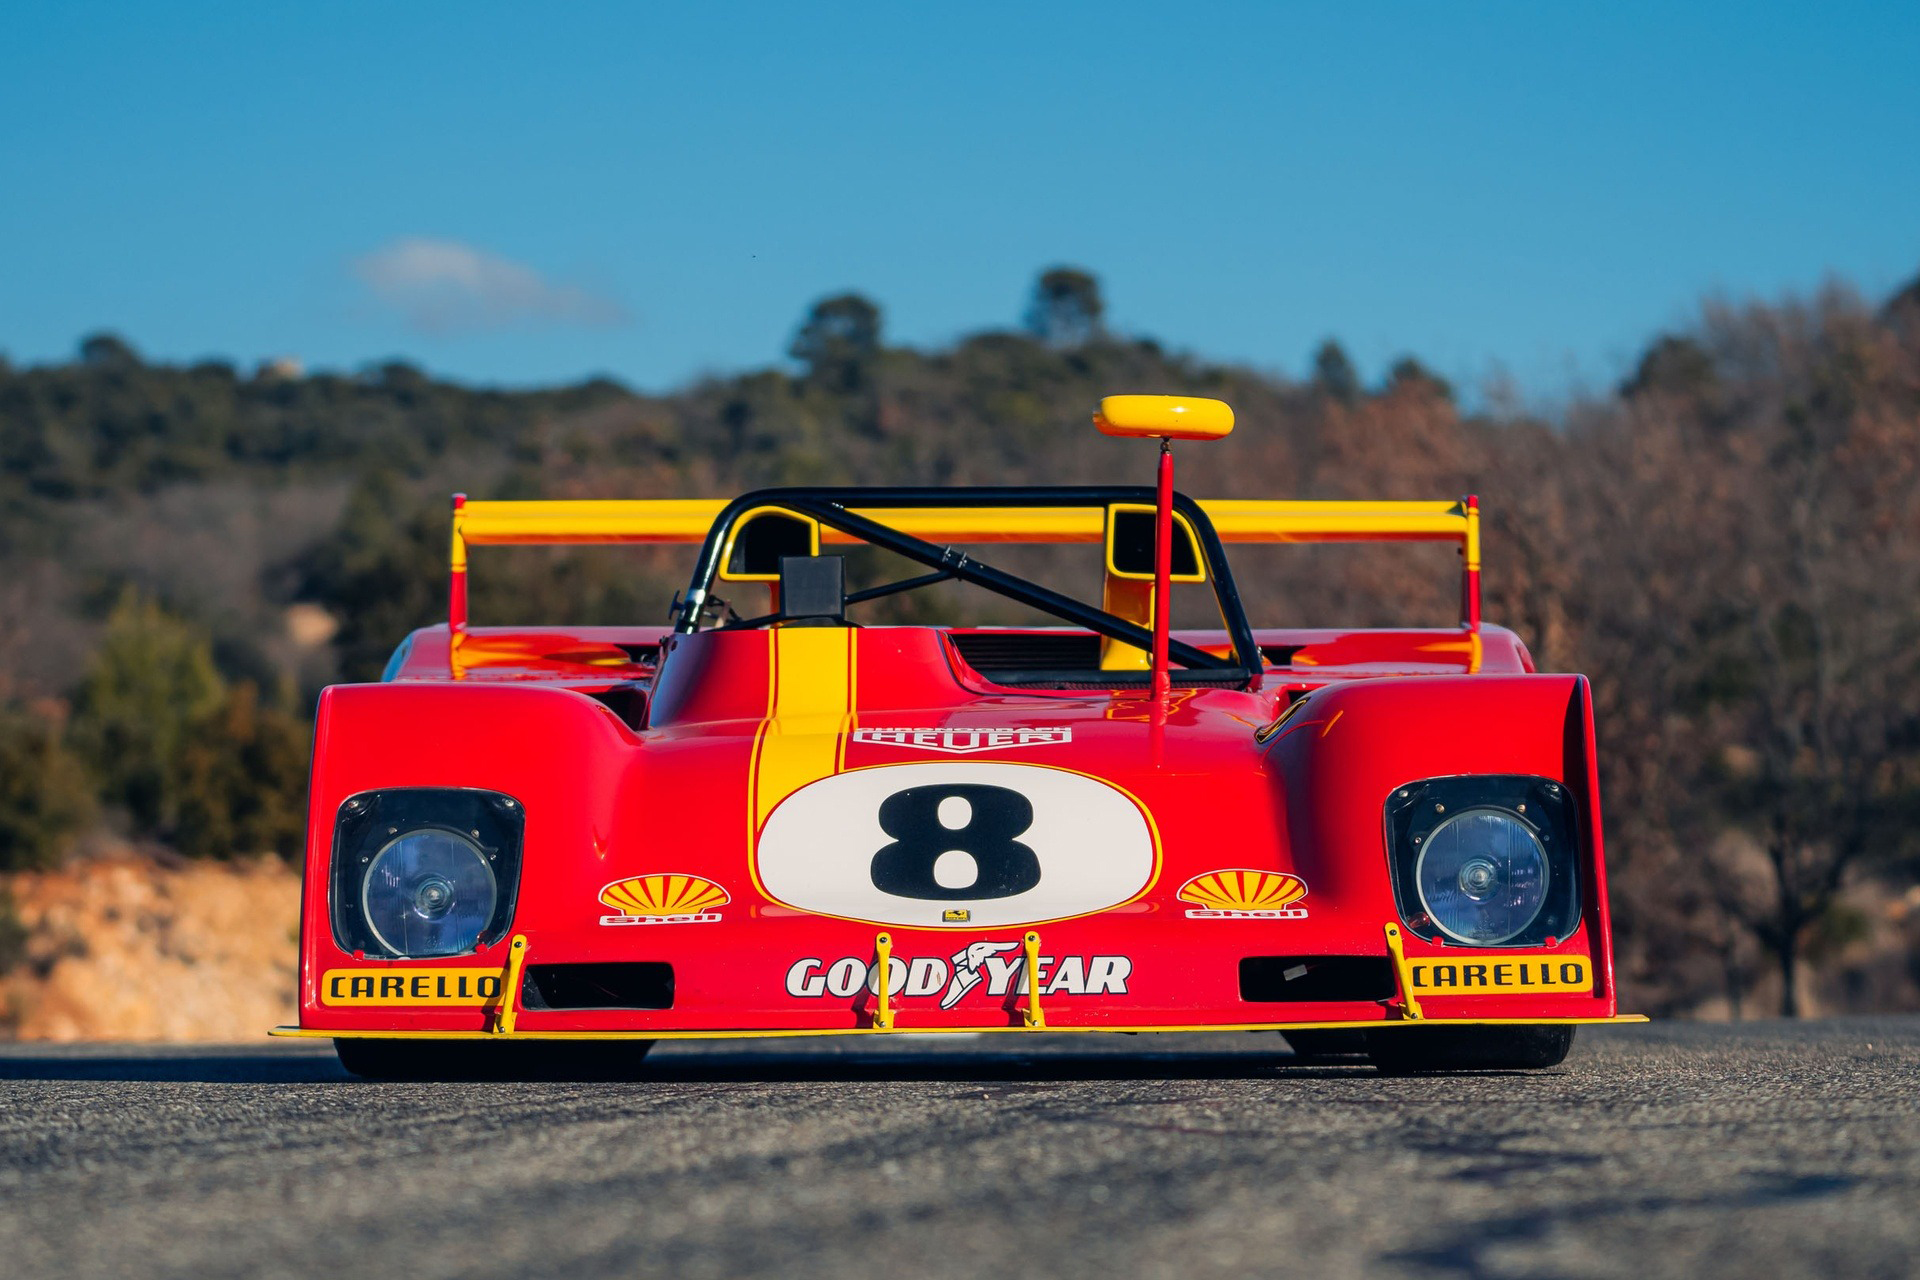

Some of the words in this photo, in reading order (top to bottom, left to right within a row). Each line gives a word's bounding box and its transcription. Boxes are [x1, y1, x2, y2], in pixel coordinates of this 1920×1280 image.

[871, 732, 1056, 749] HEUER
[870, 783, 1042, 901] 8
[606, 915, 718, 923] Shell
[1191, 910, 1303, 918] Shell
[1412, 963, 1584, 988] CARELLO
[330, 976, 502, 998] CARELLO
